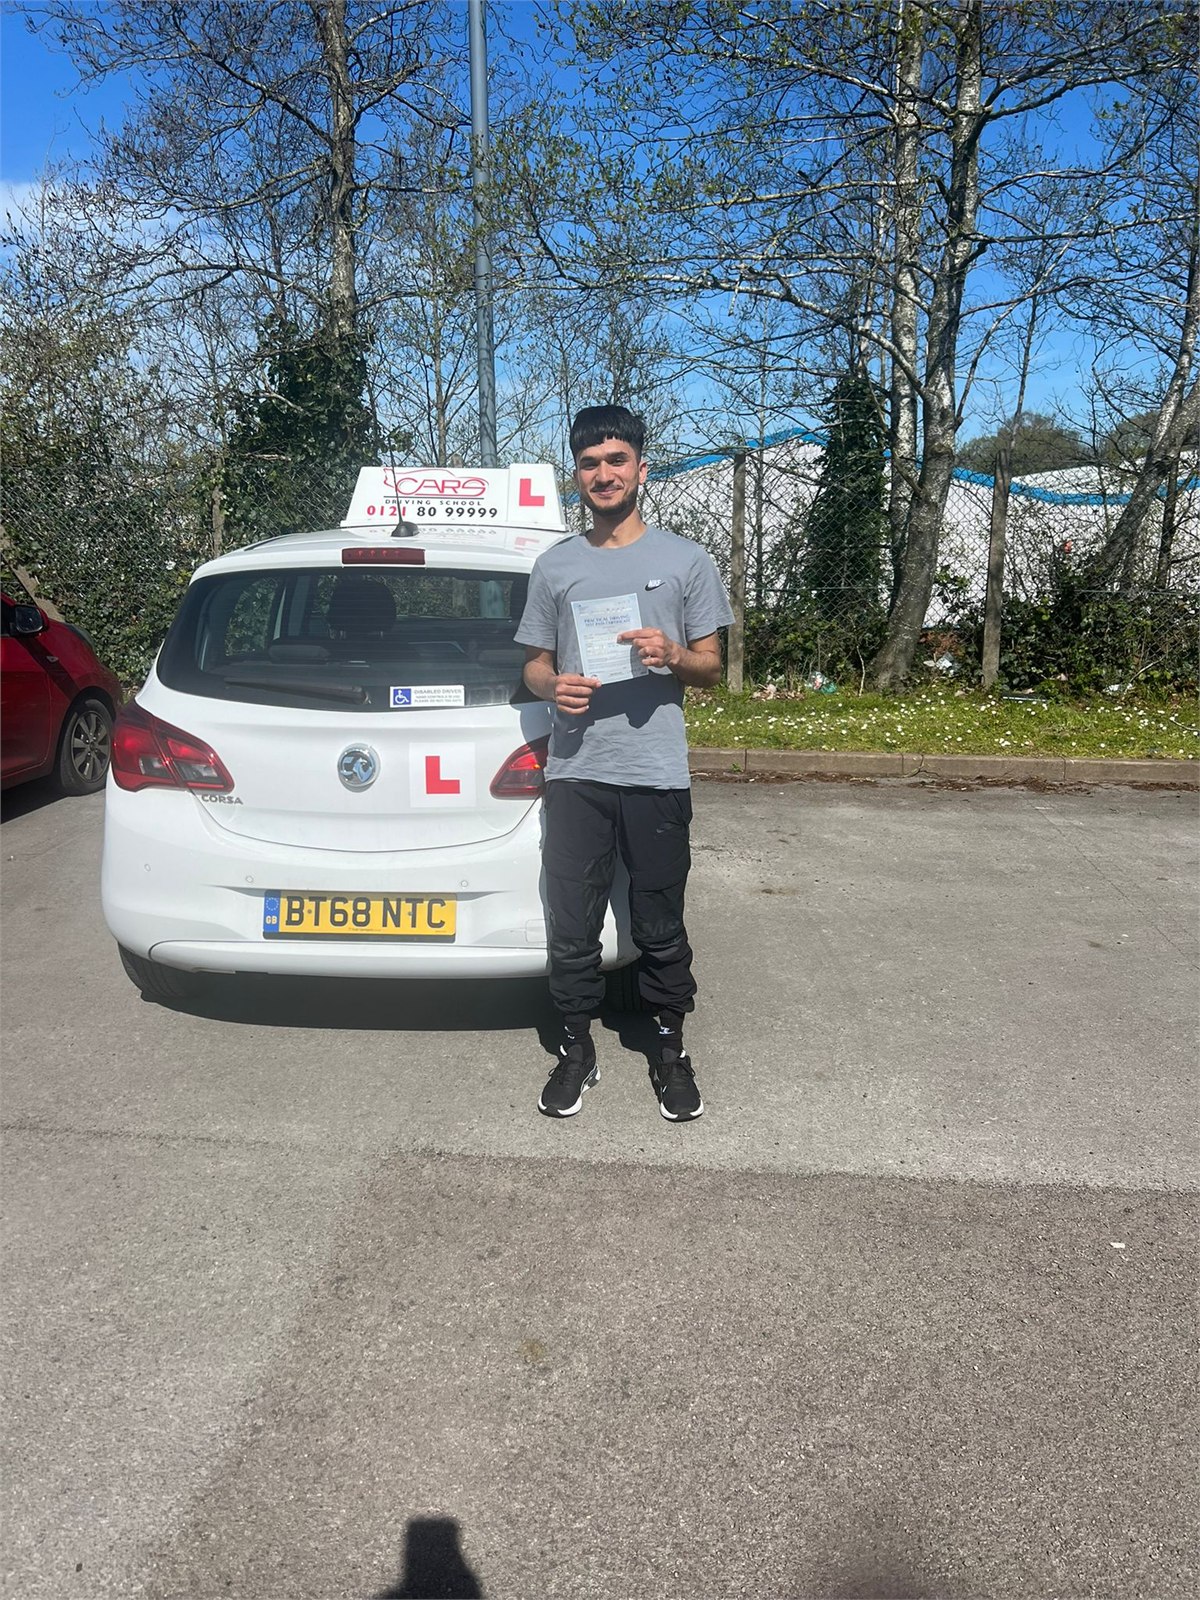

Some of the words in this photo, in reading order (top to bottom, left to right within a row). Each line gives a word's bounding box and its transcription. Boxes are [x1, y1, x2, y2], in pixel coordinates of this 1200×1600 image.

[396, 476, 487, 497] CARS
[518, 478, 545, 506] L
[367, 505, 407, 516] 0121
[416, 506, 437, 517] 80
[445, 507, 498, 518] 99999
[425, 756, 460, 794] L
[201, 794, 244, 805] CORSA
[265, 915, 278, 924] GB
[285, 896, 371, 927] BT68
[382, 897, 447, 928] NTC
